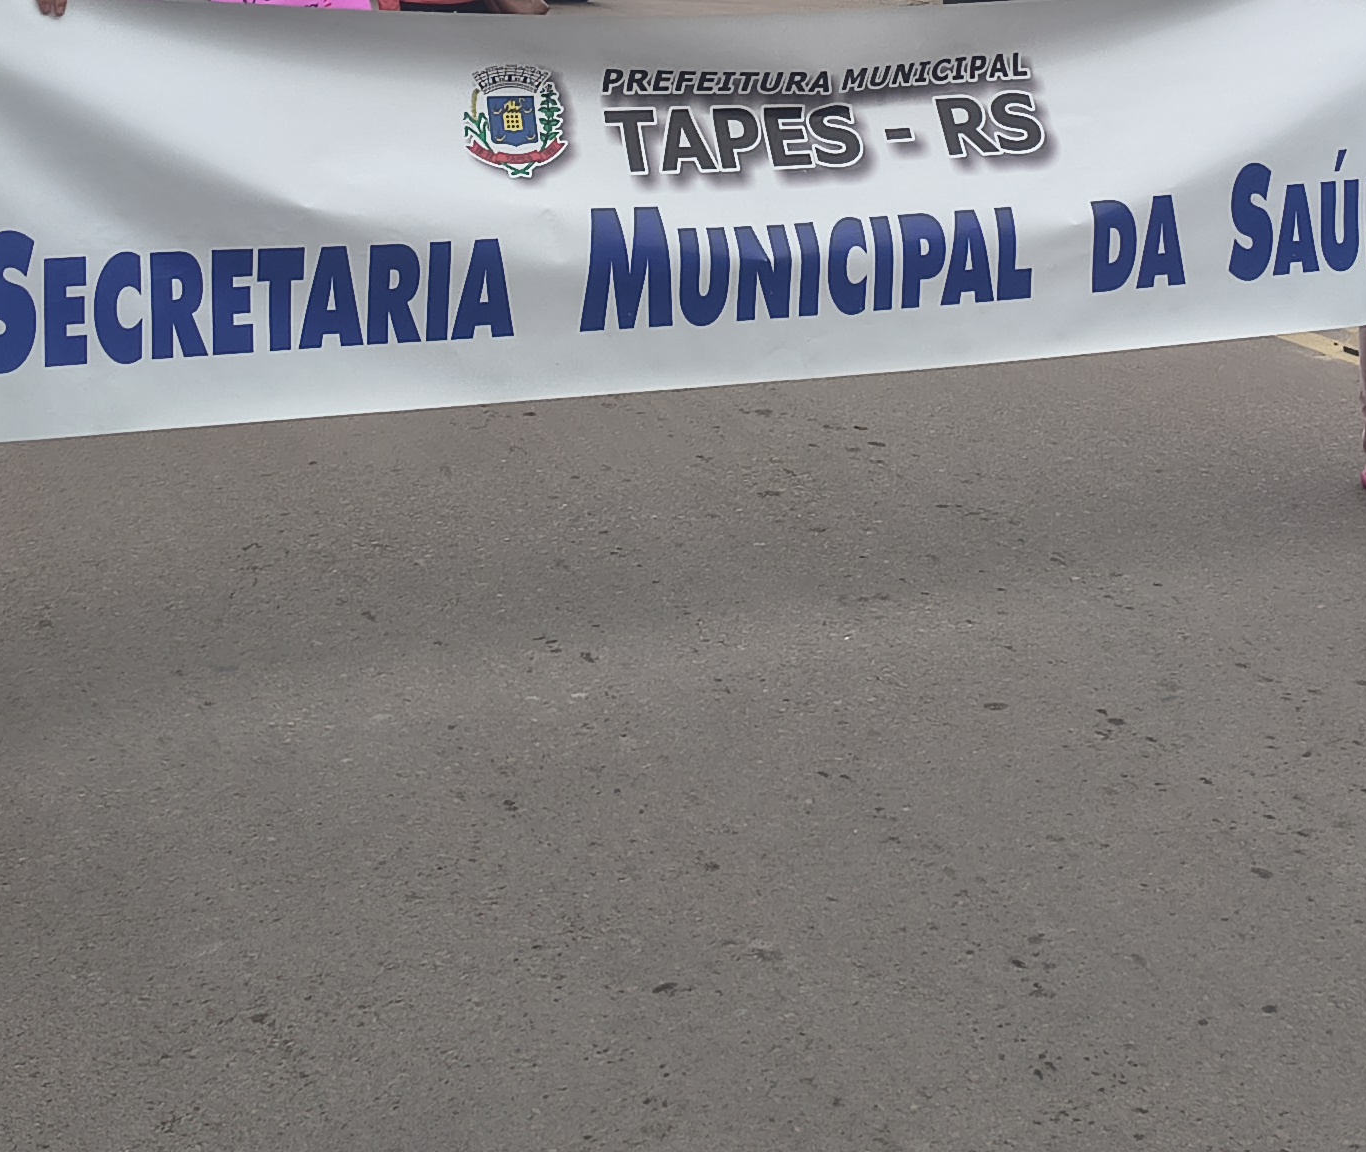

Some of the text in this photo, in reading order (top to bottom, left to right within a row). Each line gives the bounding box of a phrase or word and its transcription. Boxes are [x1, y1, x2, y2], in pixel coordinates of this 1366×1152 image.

[602, 53, 1031, 96] PREFEITURA MUNICIPAL
[604, 90, 1047, 175] TAPES - RS
[580, 205, 1032, 333] MUNICIPAL
[1090, 194, 1187, 294] DA
